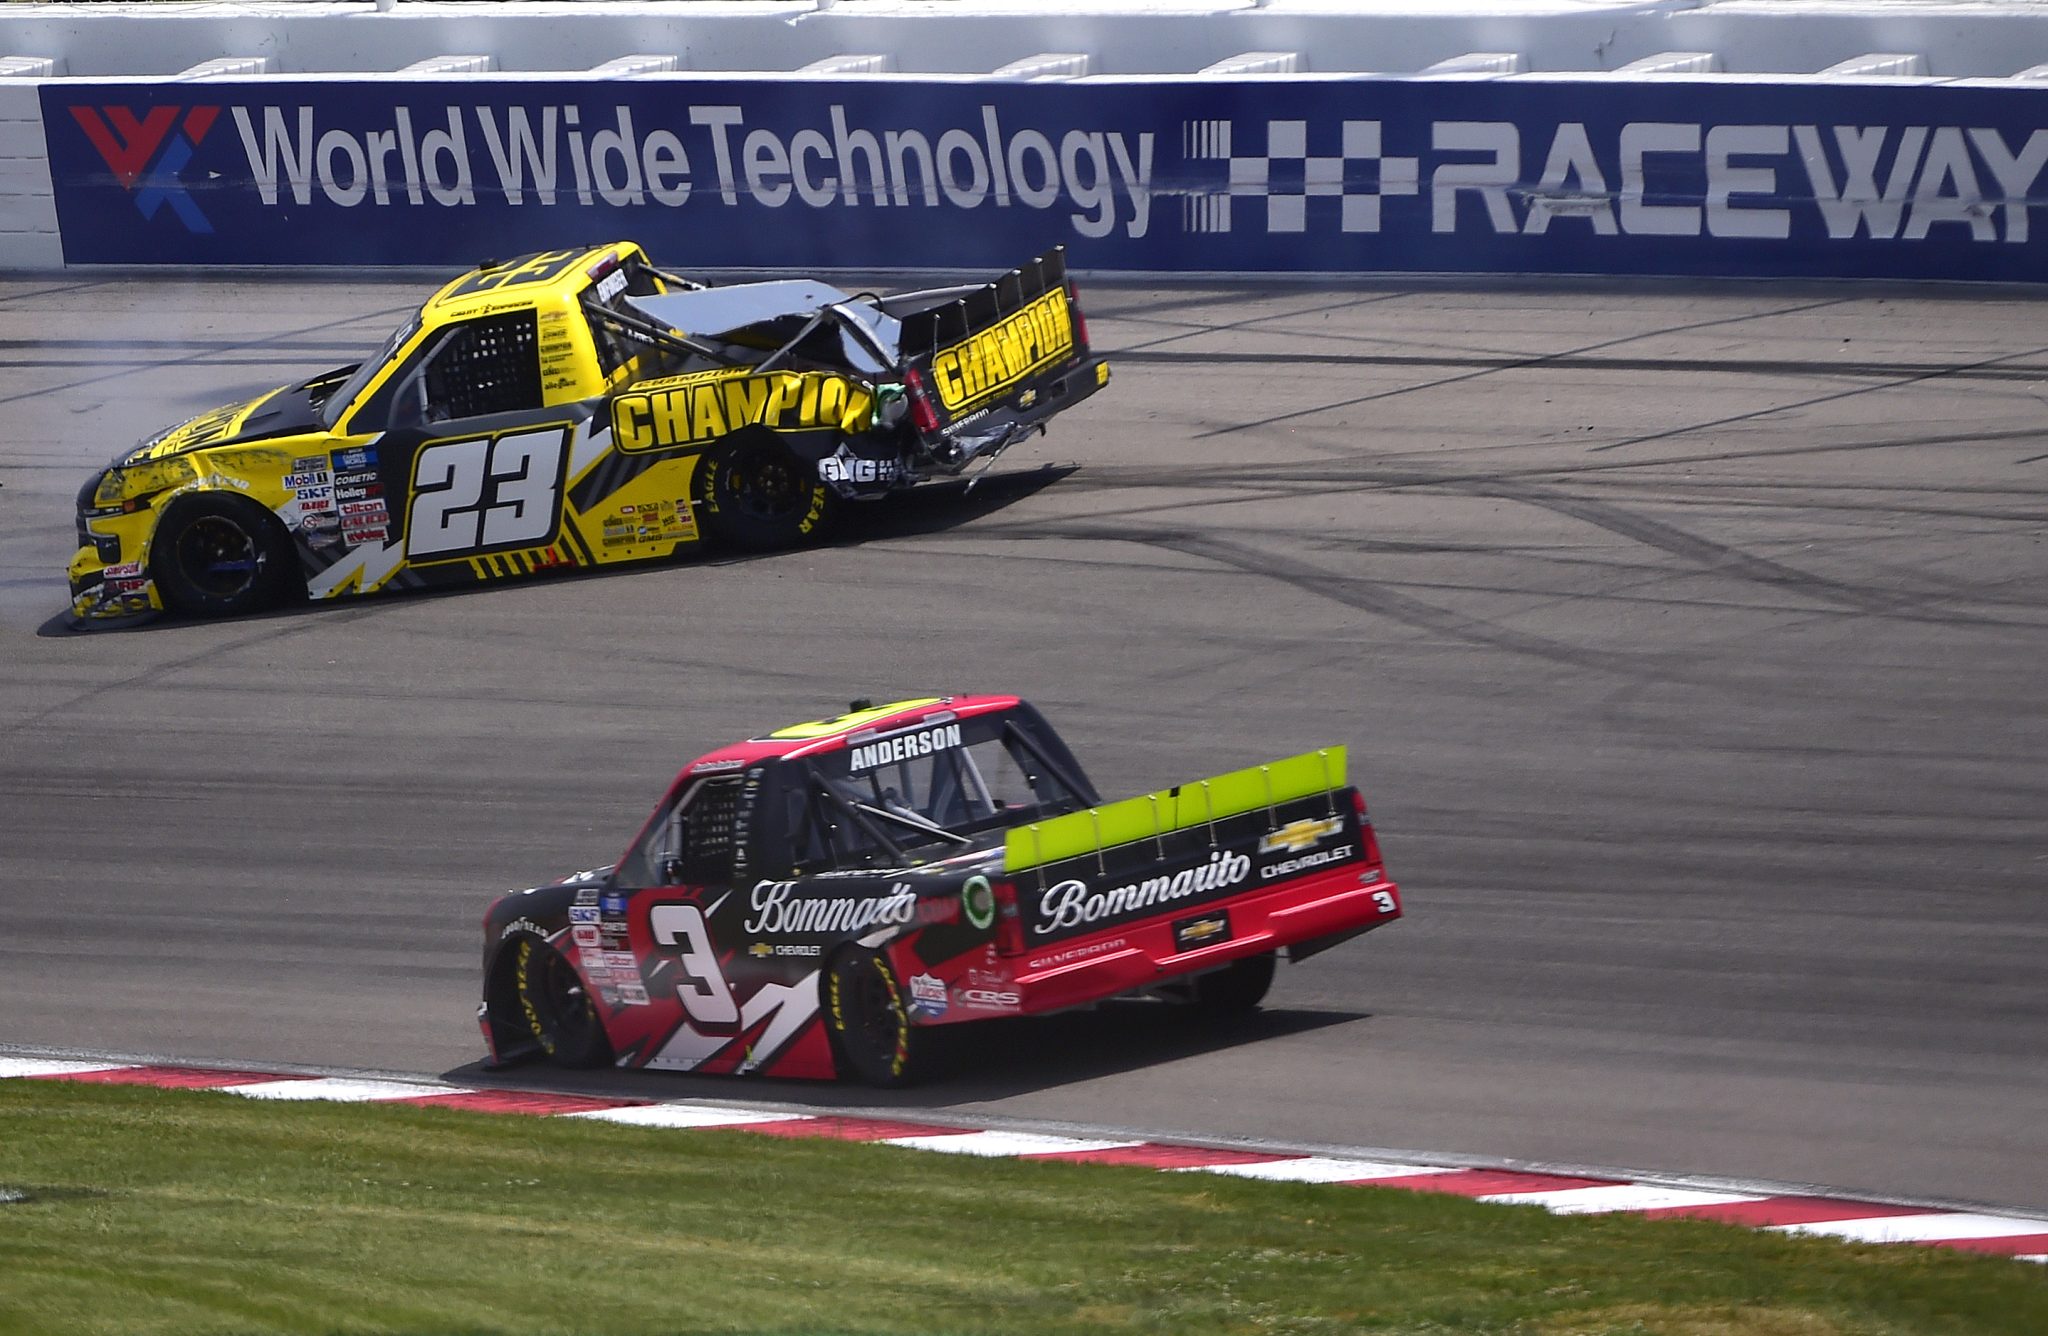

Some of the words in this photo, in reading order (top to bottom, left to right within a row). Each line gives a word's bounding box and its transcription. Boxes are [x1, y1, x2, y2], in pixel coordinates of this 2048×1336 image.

[231, 105, 472, 206] World
[476, 105, 692, 206] Wide
[688, 104, 1155, 239] Technology
[1431, 120, 2048, 243] RACEWAY
[934, 291, 1071, 403] CHAMPION
[284, 474, 316, 488] Mobil
[297, 486, 333, 500] SKF
[335, 472, 377, 486] COMETIC
[336, 487, 367, 500] Holley
[408, 429, 564, 556] 23
[704, 459, 719, 513] EAGLE
[342, 502, 384, 514] tilton
[850, 723, 962, 772] ANDERSON
[1261, 844, 1354, 879] CHEVROLET
[1034, 849, 1251, 935] Bommarito
[1372, 891, 1396, 914] 3
[569, 908, 600, 923] SKF
[650, 904, 738, 1022] 3
[775, 945, 821, 956] CHEVROLET
